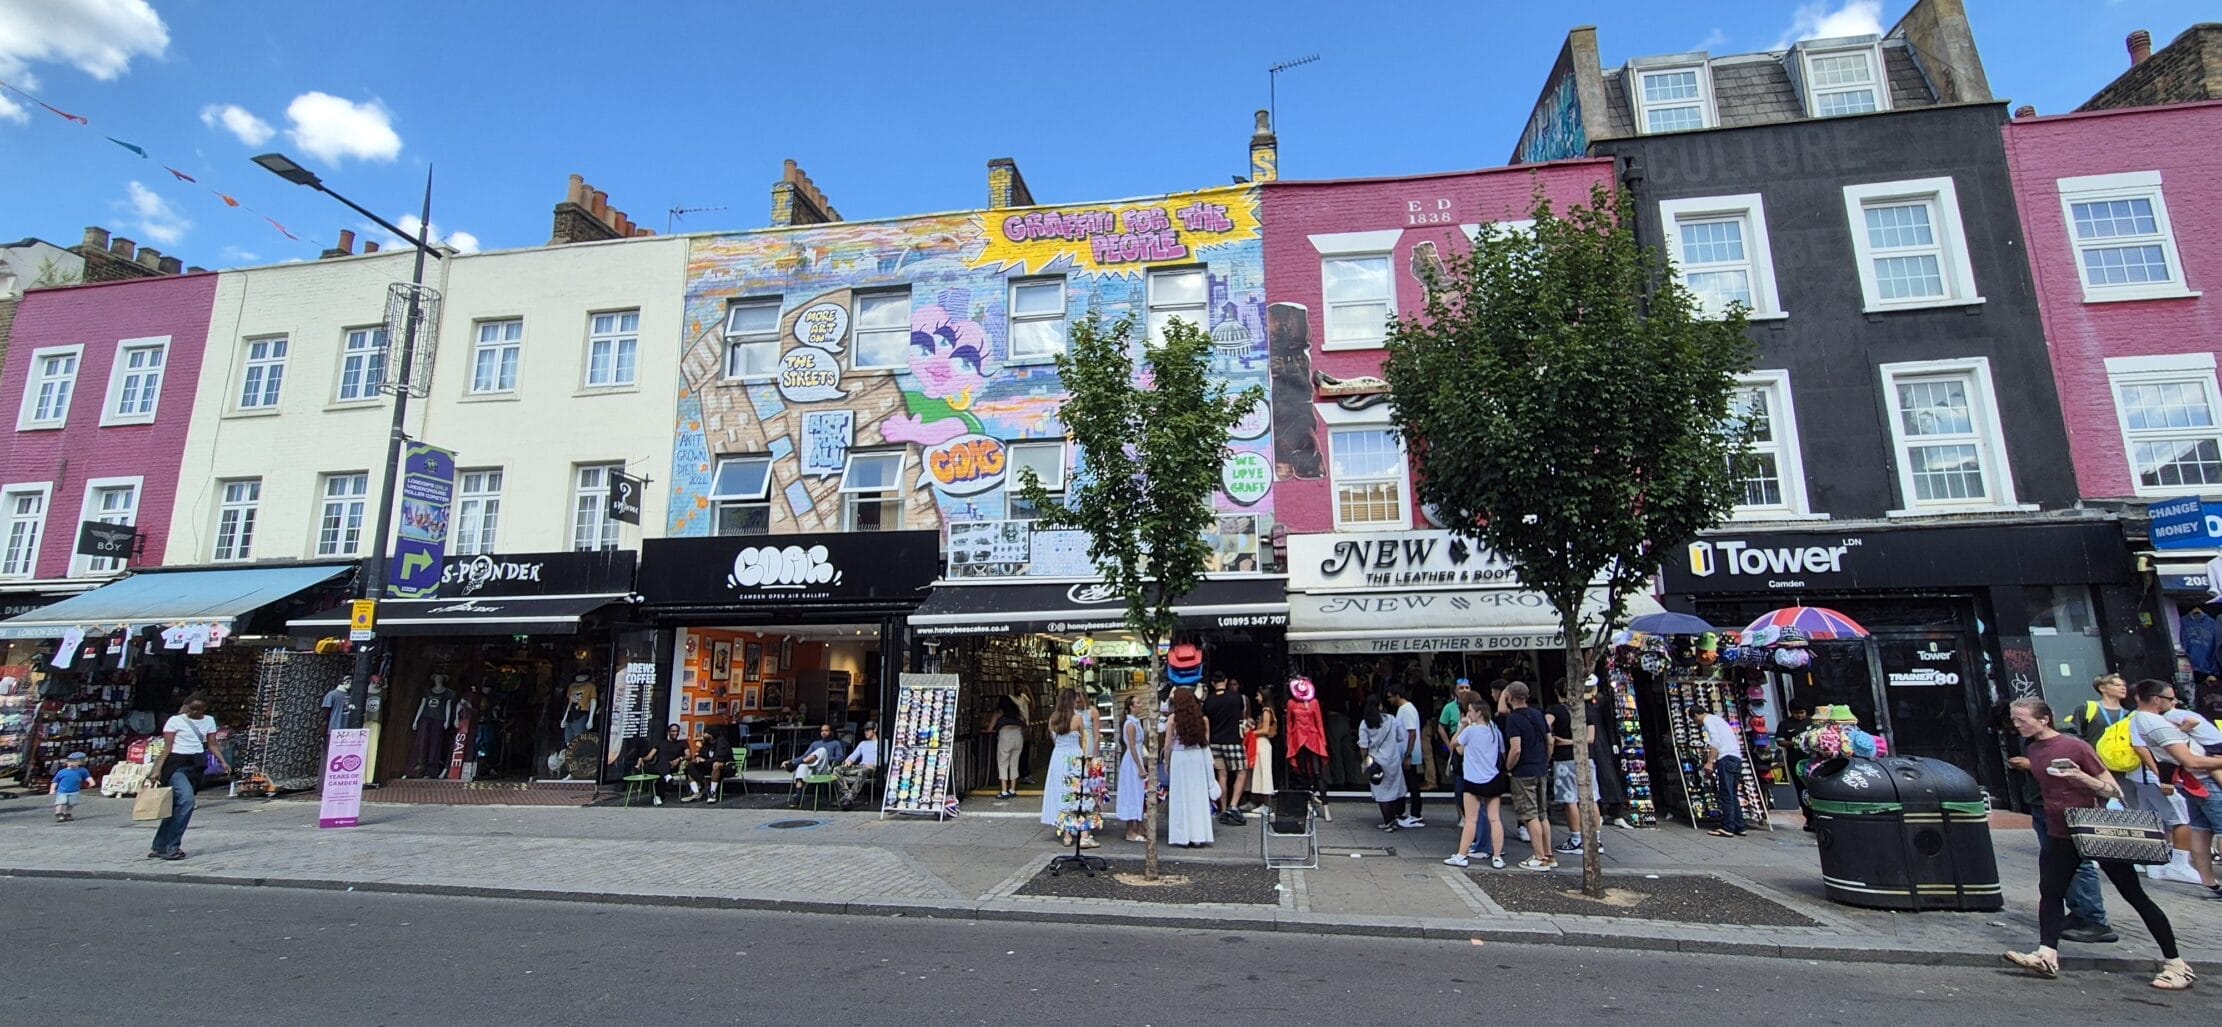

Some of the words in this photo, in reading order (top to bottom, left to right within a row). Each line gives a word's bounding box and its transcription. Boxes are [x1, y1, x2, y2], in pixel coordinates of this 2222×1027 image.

[1408, 201, 1422, 212] E
[1437, 199, 1451, 210] D
[1003, 210, 1114, 242] GRAFFITI
[1122, 207, 1170, 234] FOR
[1177, 202, 1233, 233] THE
[1408, 212, 1451, 224] 1838
[1091, 229, 1188, 264] PEOPLE
[805, 310, 837, 322] MORE
[810, 322, 837, 333] ART
[784, 354, 815, 369] THE
[783, 370, 835, 387] STREETS
[808, 414, 849, 434] ART
[930, 438, 1005, 484] COAG
[1235, 456, 1256, 465] WE
[2148, 502, 2199, 519] CHANGE
[2155, 521, 2198, 537] MONEY
[98, 541, 121, 551] BOY
[1842, 538, 1862, 546] LDN
[1321, 538, 1438, 576] NEW
[1716, 541, 1847, 575] Tower
[1366, 573, 1390, 584] THE
[1396, 571, 1455, 583] LEATHER
[1460, 571, 1469, 581] &
[1768, 580, 1805, 588] Camden
[1320, 596, 1437, 613] NEW
[1223, 618, 1249, 627] 01895
[1251, 617, 1267, 626] 347
[1270, 616, 1286, 625] 707
[1371, 640, 1398, 651] THE
[1405, 639, 1469, 650] LEATHER
[1474, 638, 1484, 648] &
[1489, 636, 1531, 648] BOOT
[1917, 651, 1951, 660] Tower
[627, 662, 656, 673] BREWS
[625, 674, 656, 684] COFFEE
[1889, 672, 1936, 681] TRAINER
[1935, 672, 1959, 685] 80
[451, 733, 466, 767] SALE
[330, 755, 361, 772] 60
